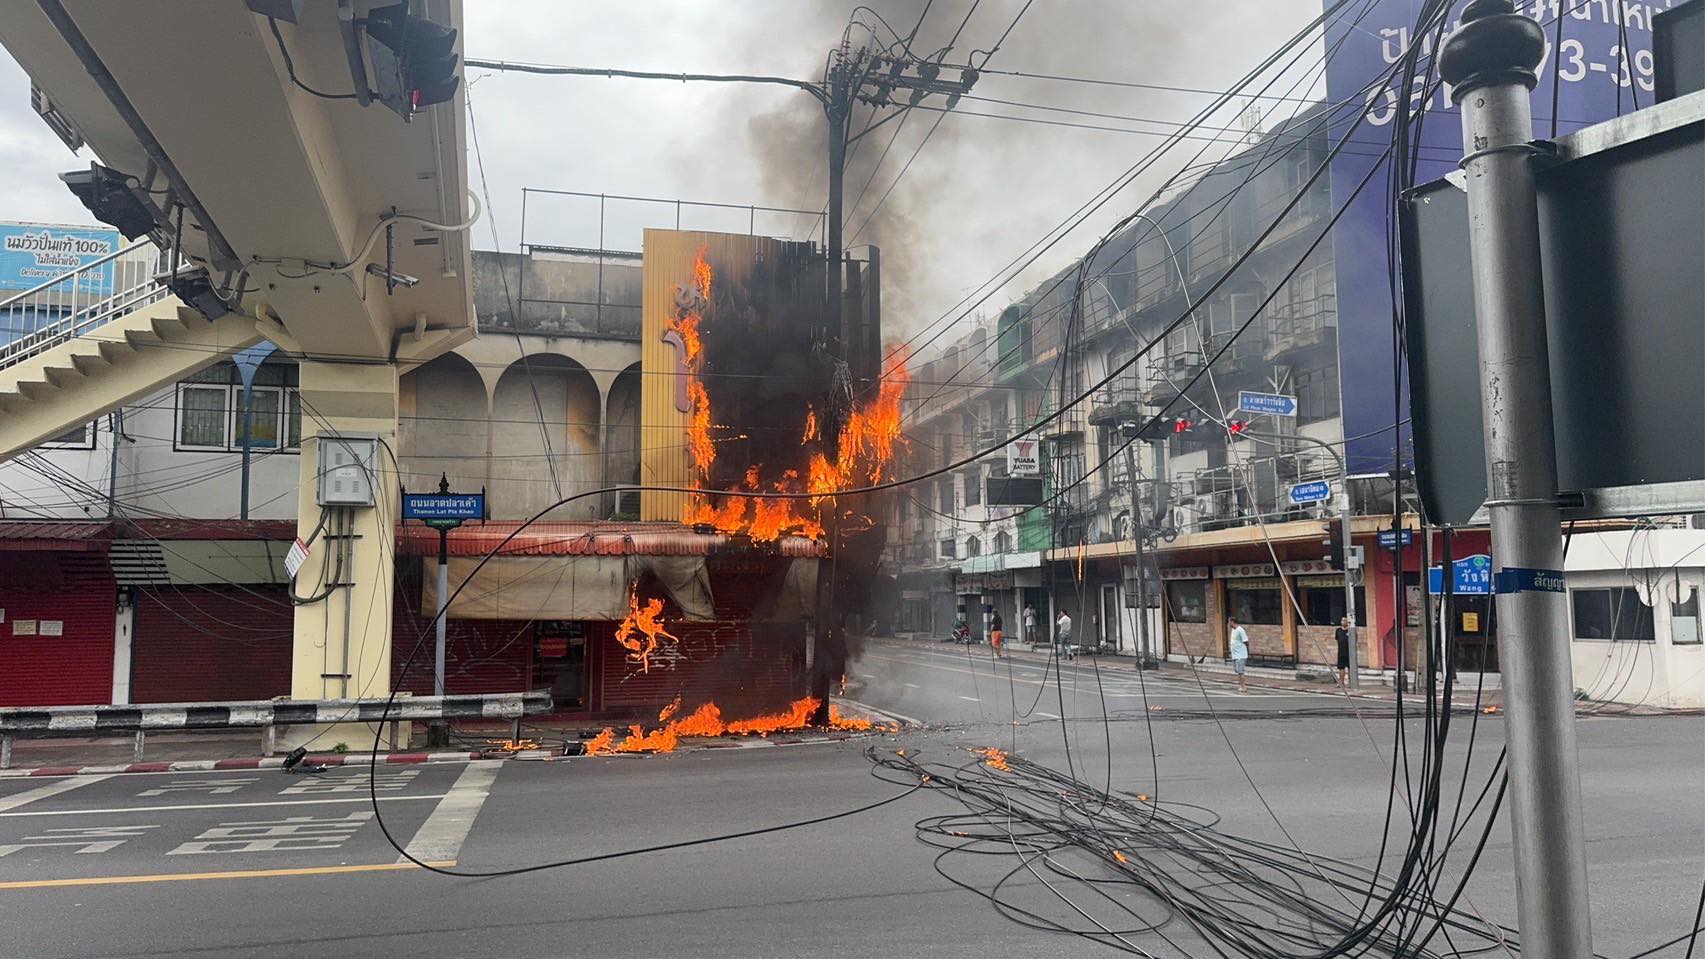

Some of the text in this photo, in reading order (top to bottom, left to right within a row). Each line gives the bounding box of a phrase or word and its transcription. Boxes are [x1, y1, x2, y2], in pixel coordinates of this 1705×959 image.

[75, 240, 108, 254] 100%
[410, 497, 476, 508] ถนนลาดปลาเค้า
